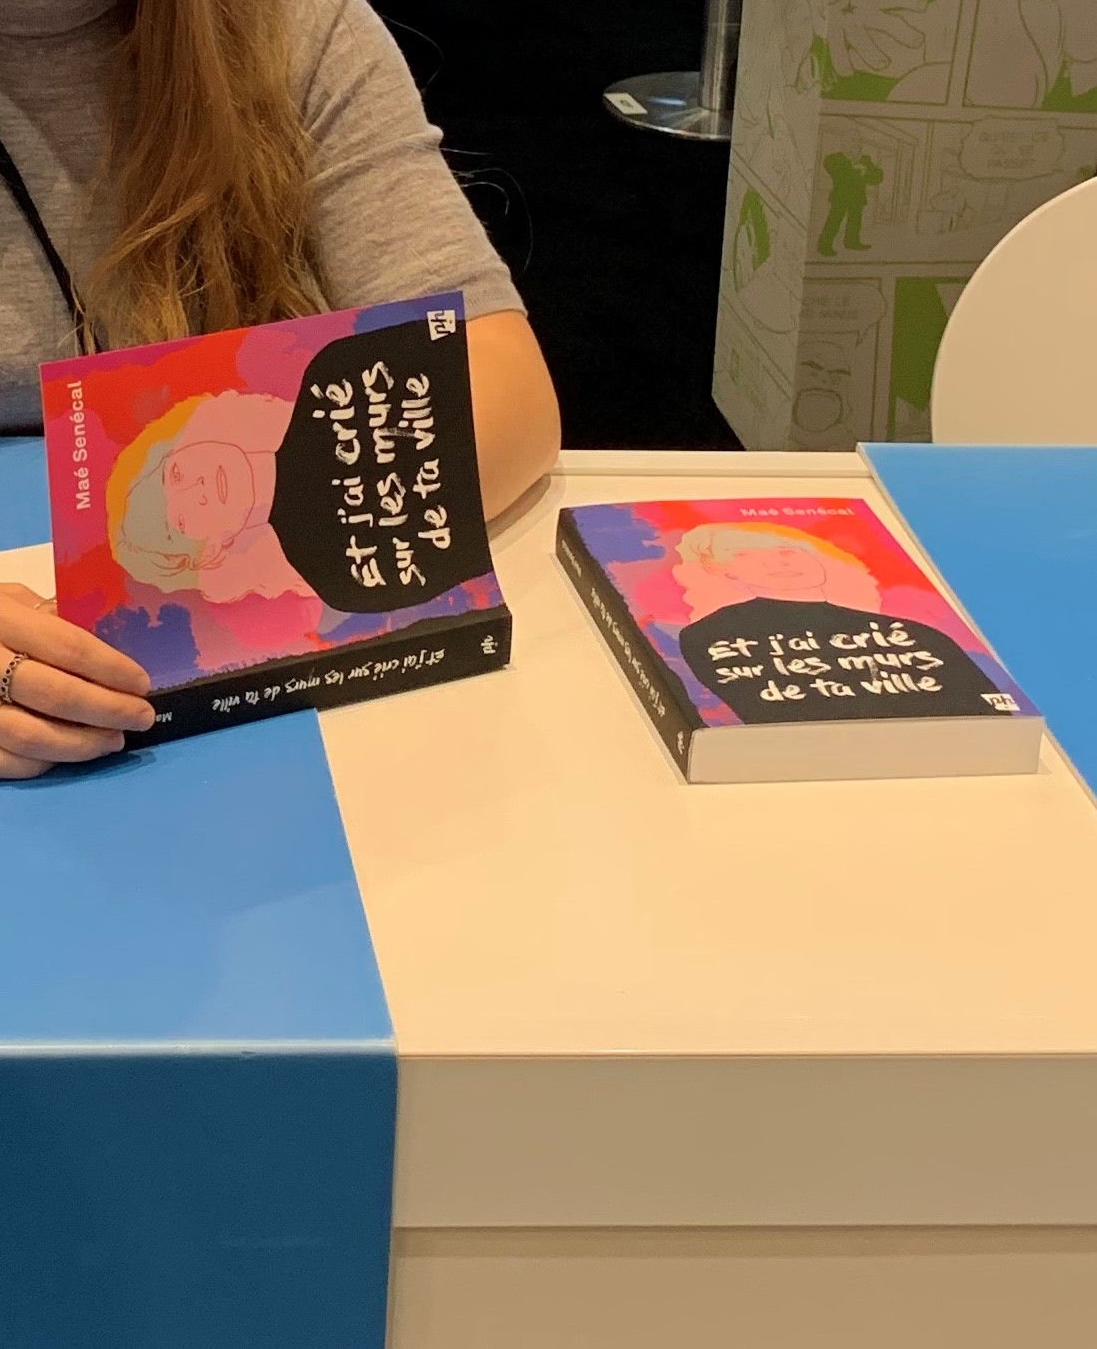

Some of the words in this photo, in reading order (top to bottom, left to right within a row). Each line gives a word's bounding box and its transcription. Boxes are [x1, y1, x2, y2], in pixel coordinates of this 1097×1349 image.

[67, 380, 88, 462] Senécal
[311, 379, 361, 465] crié
[362, 360, 403, 464] murs
[399, 373, 436, 450] ville
[73, 467, 91, 510] Maé
[413, 458, 441, 499] ta
[332, 476, 373, 527] j'ai
[376, 472, 408, 526] les
[740, 507, 780, 517] Maé
[782, 507, 855, 517] Senécal
[418, 505, 451, 549] de
[346, 535, 386, 587] Et
[393, 537, 426, 586] sur
[708, 638, 758, 661] Et
[768, 631, 819, 656] j'ai
[830, 621, 916, 650] crié
[324, 669, 343, 685] les
[347, 663, 374, 678] sur
[372, 659, 400, 682] crié
[402, 649, 428, 675] j'ai
[716, 664, 764, 683] sur
[773, 655, 831, 676] les
[838, 650, 944, 677] murs
[244, 690, 260, 706] ta
[263, 681, 280, 697] de
[285, 668, 321, 694] murs
[760, 680, 806, 702] de
[810, 678, 856, 698] ta
[861, 673, 943, 696] ville
[155, 710, 173, 724] Ma
[212, 694, 241, 713] ville
